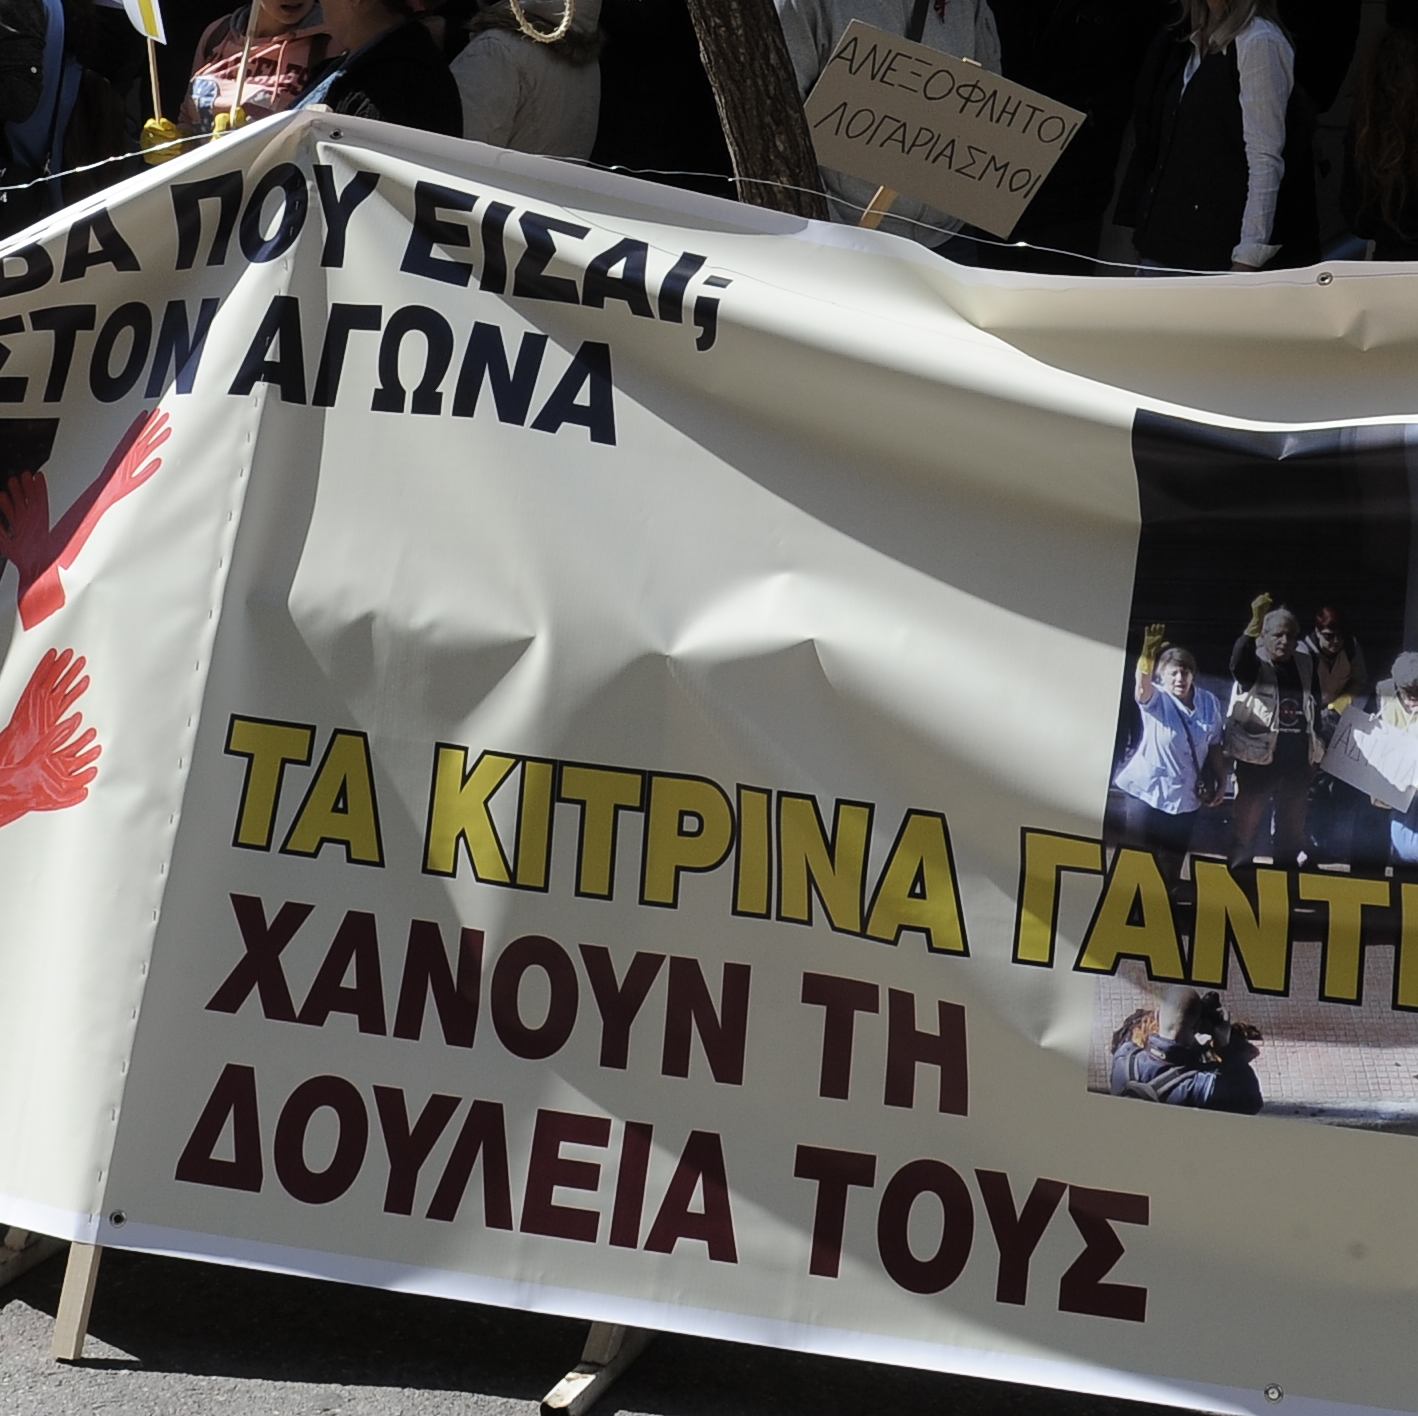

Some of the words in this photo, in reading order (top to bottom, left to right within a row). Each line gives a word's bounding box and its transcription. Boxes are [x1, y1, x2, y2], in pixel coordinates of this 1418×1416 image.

[813, 101, 1043, 199] ΛΟΓΑΡΙΑΣΜΟΙ
[827, 36, 1079, 151] ΑΝΕΞΟΦΛΗΤΟΙ
[170, 161, 384, 273] ΠΟΥ
[398, 190, 732, 353] ΕΙΣΑΙ;
[229, 294, 618, 447] ΑΓΩΝΑ
[224, 713, 386, 869] ΤΑ
[422, 740, 971, 958] ΚΙΤΡΙΝΑ
[205, 891, 751, 1087] ΧΑΝΟΥΝ
[800, 969, 970, 1118] ΤΗ
[174, 1061, 740, 1264] ΔΟΥΛΕΙΑ
[793, 1143, 1151, 1324] ΤΟΥΣ
